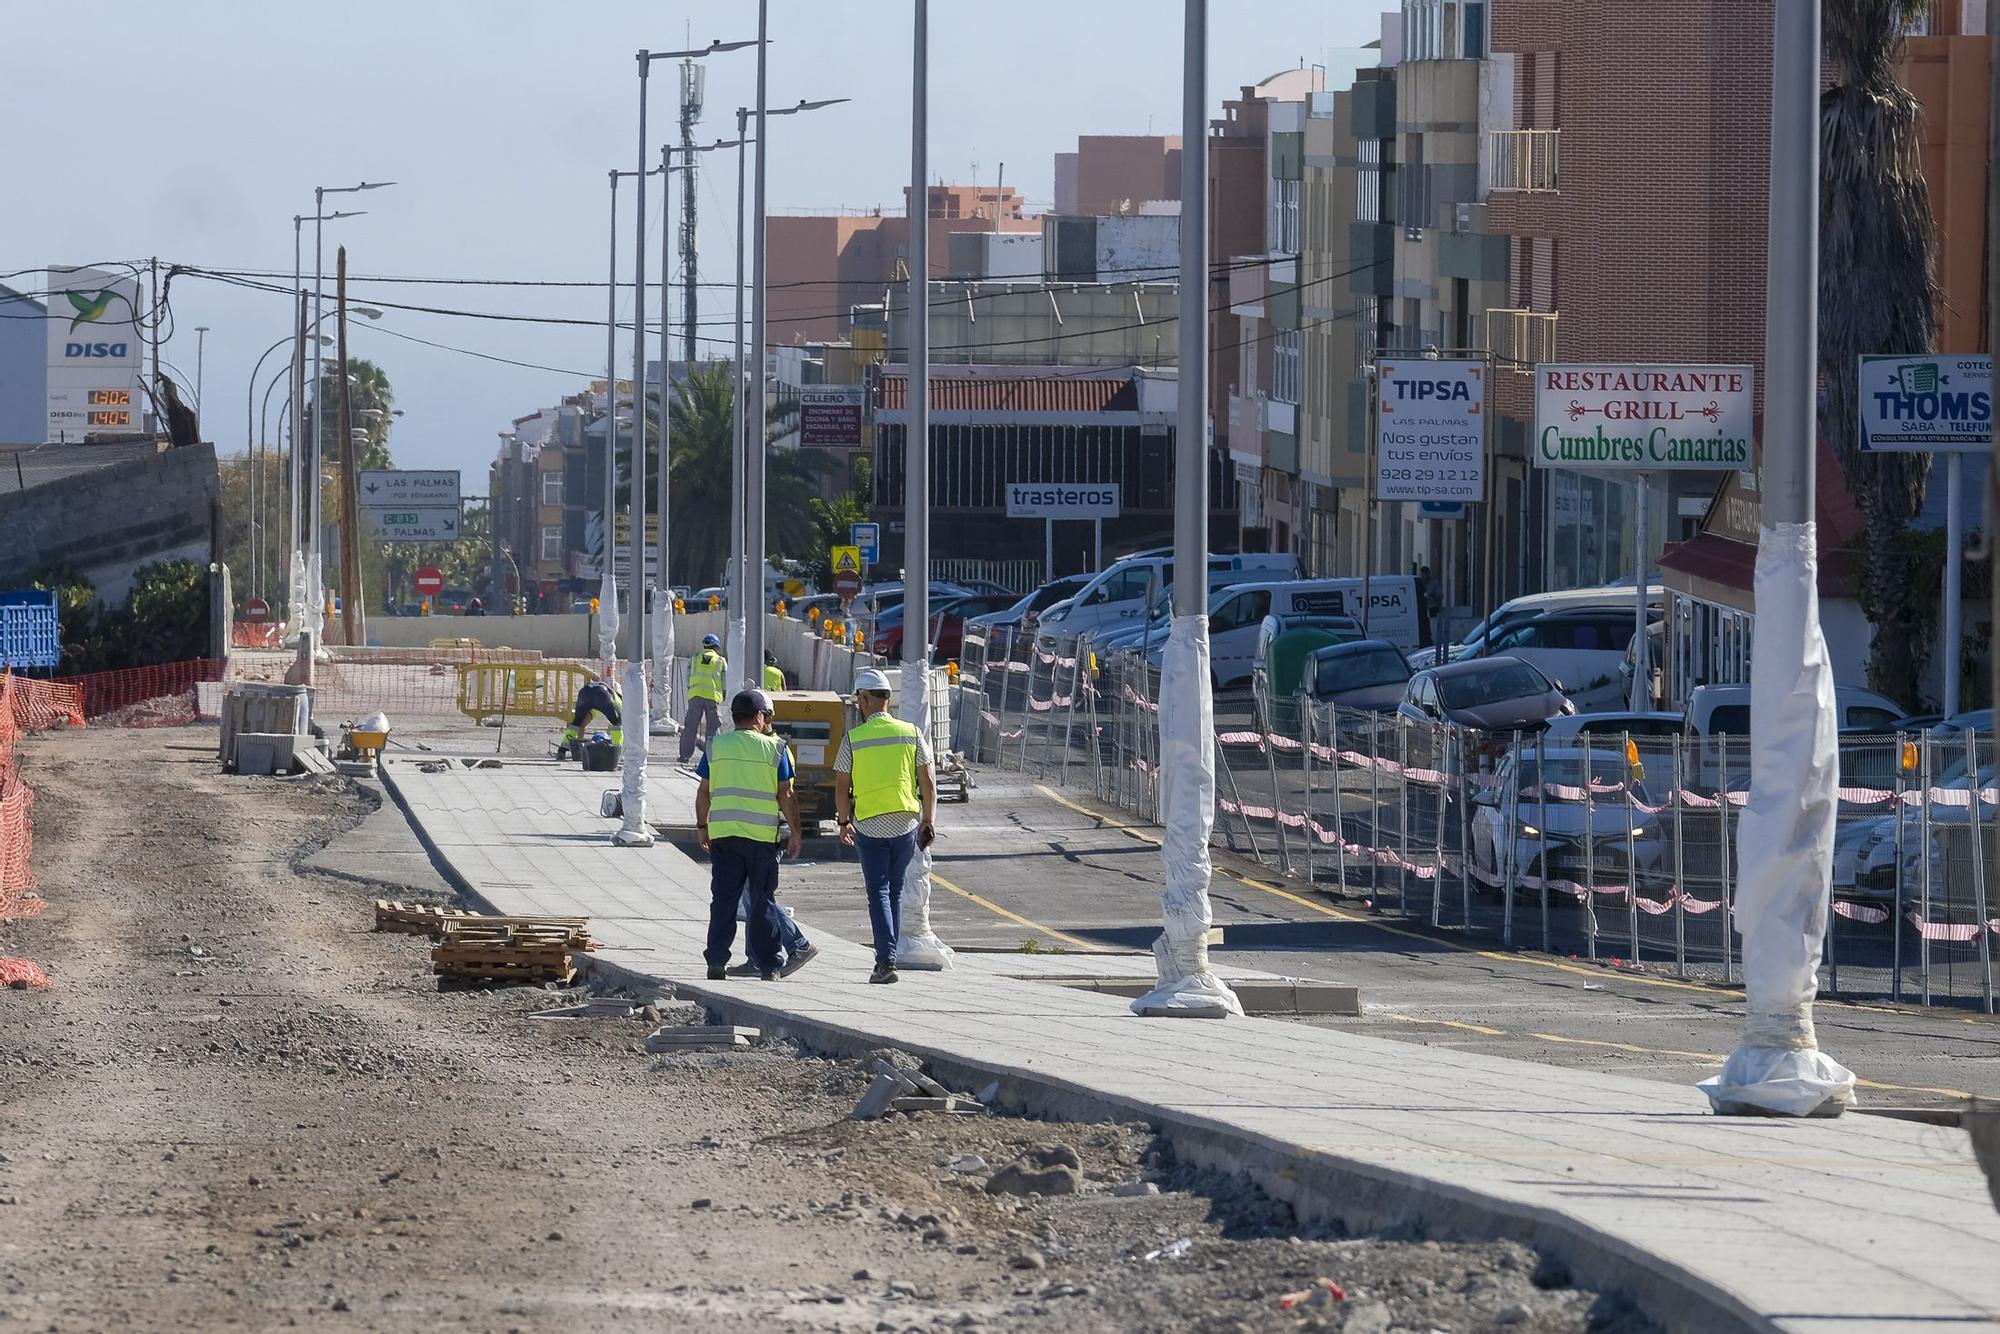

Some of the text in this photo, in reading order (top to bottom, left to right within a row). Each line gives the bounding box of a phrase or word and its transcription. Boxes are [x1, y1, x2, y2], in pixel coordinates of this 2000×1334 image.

[65, 343, 127, 358] DISA
[1546, 371, 1743, 393] RESTAURANTE
[1393, 380, 1470, 401] TIPSA
[802, 394, 845, 403] CILLERO
[1603, 400, 1685, 420] GRILL
[1874, 391, 1991, 421] THOMS
[1418, 418, 1470, 427] PALMAS
[1901, 422, 1936, 432] SABA
[1383, 432, 1478, 446] Nos gustan
[1541, 424, 1746, 462] Cumbres Canarias
[1388, 448, 1473, 461] tus envíos
[1381, 469, 1479, 481] 928 29 12 12
[386, 479, 456, 488] LAS PALMAS
[1012, 487, 1114, 506] trasteros
[1386, 485, 1473, 496] www.tip-sa.com
[394, 528, 436, 536] PALMAS
